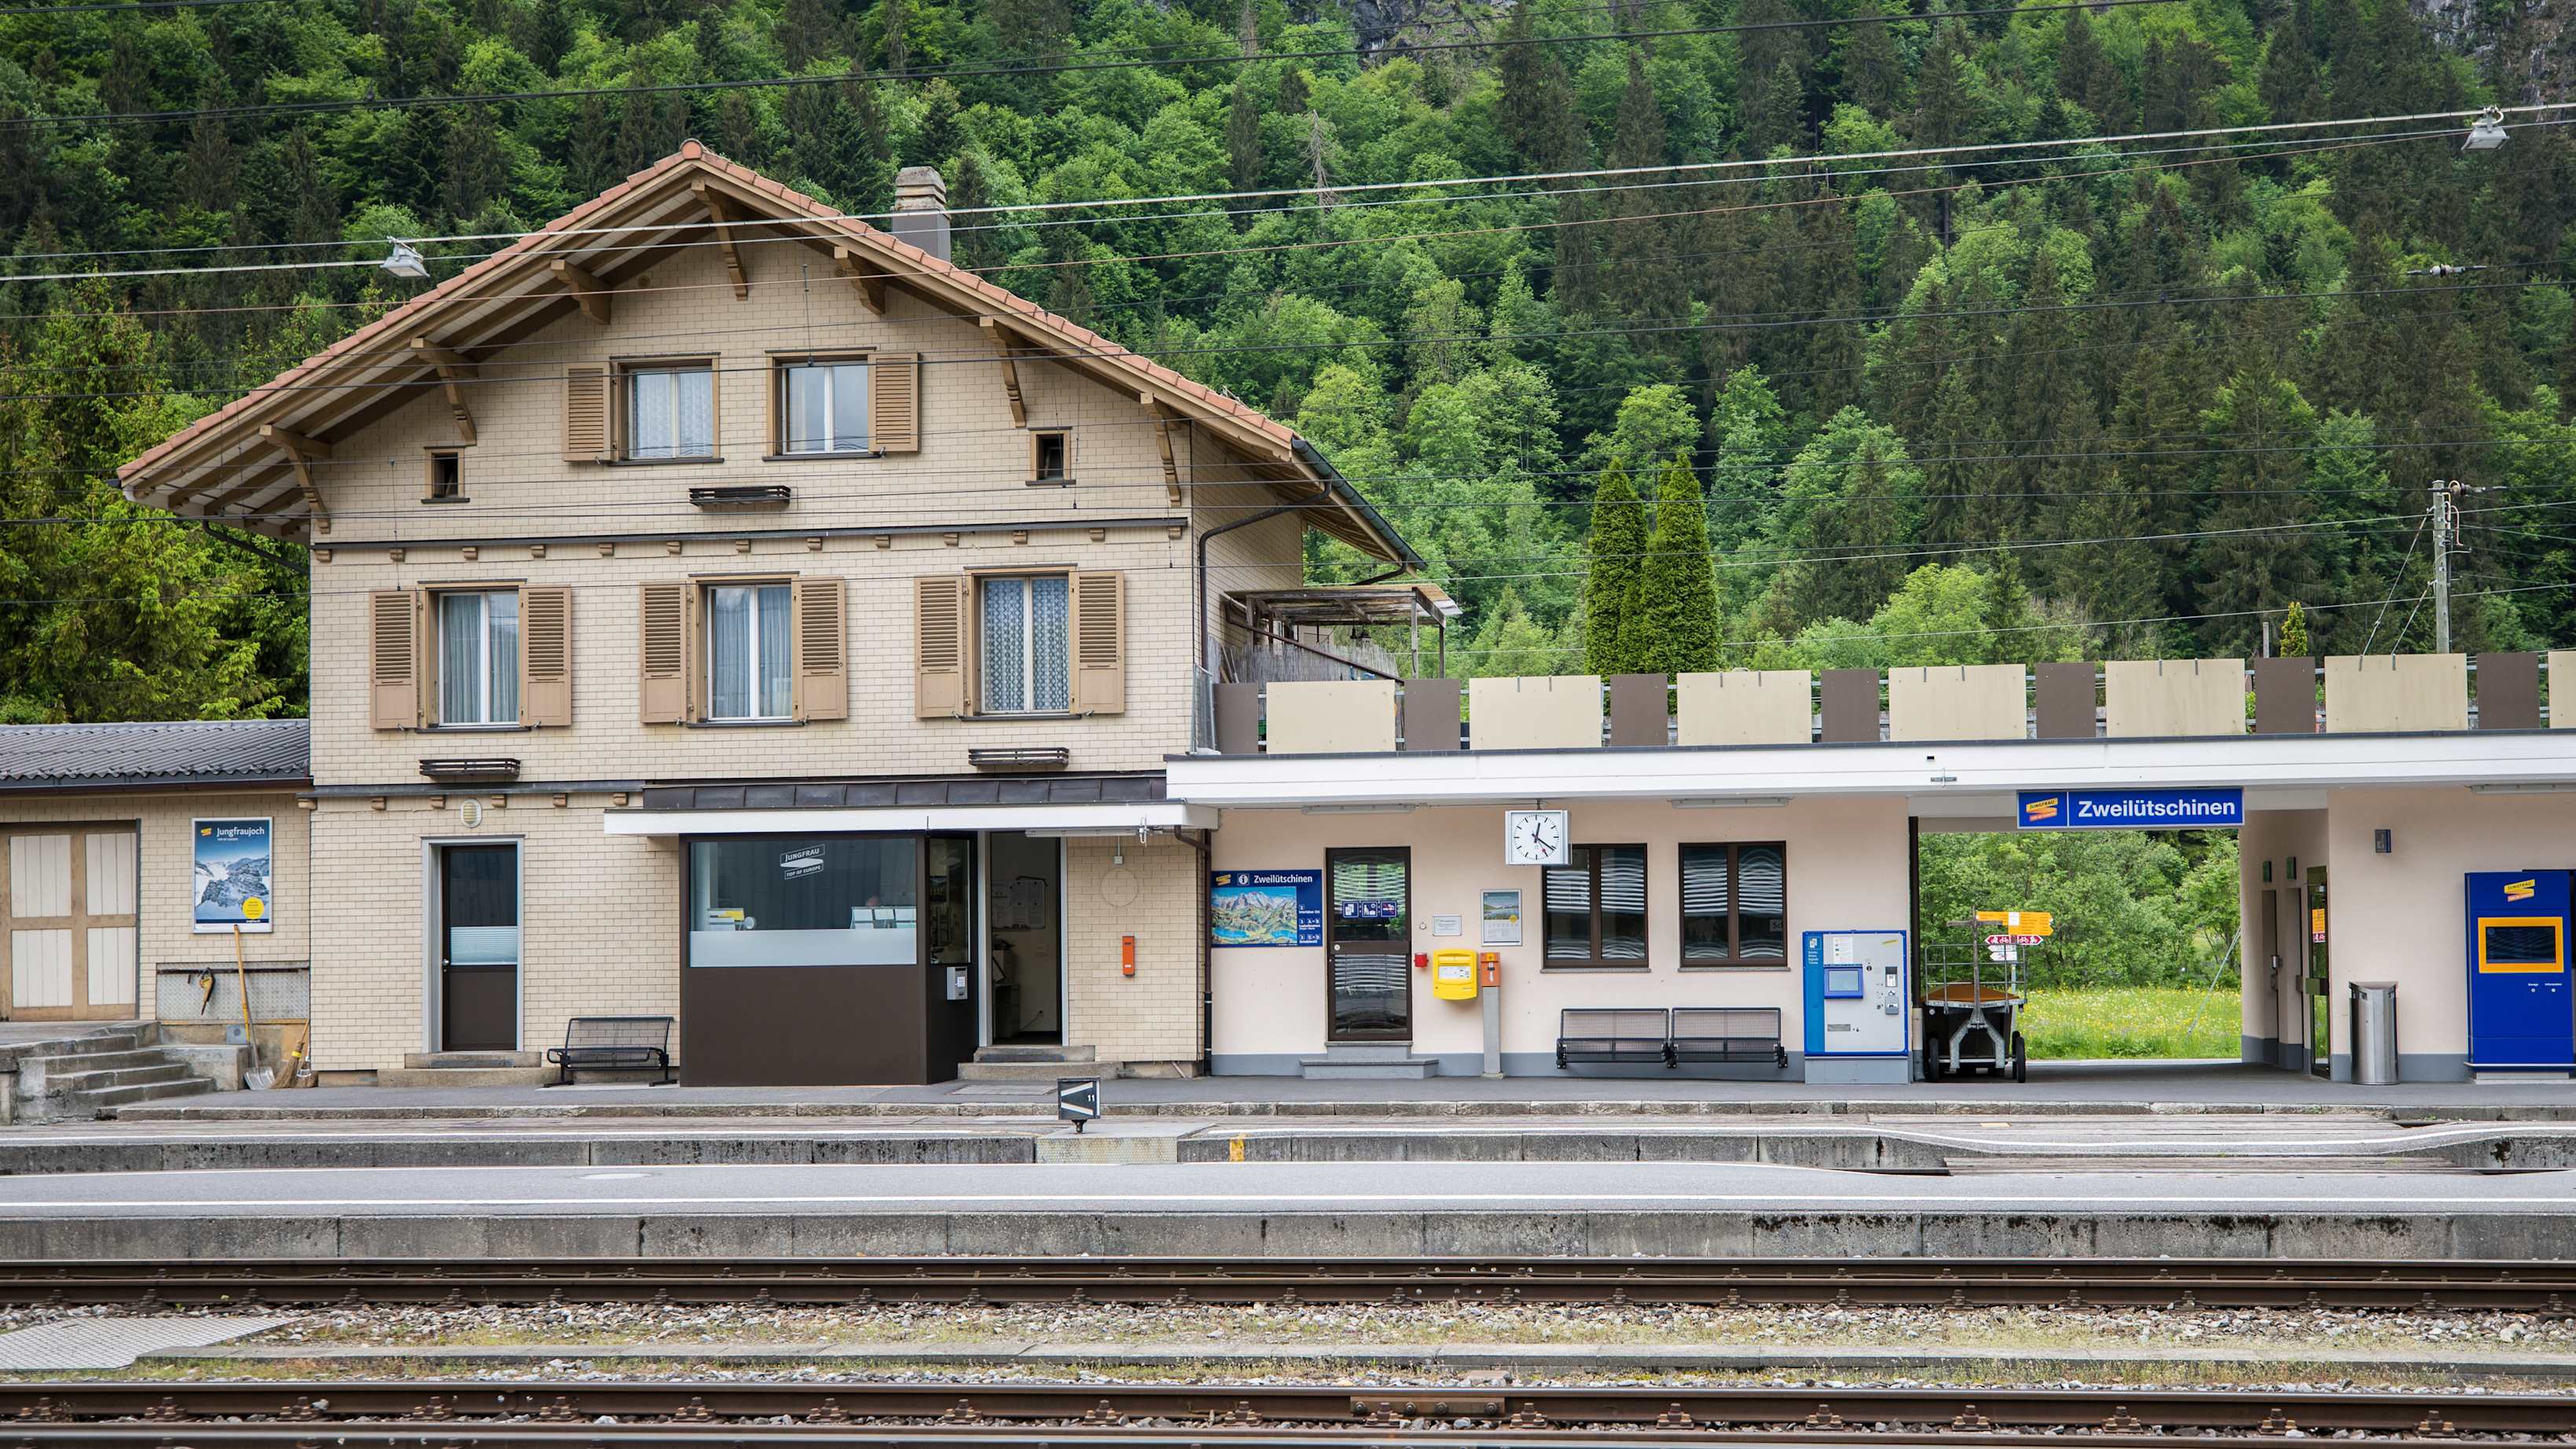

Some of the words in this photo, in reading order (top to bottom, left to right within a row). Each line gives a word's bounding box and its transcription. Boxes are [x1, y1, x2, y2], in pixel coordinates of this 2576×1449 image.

[2078, 798, 2235, 817] Zweilütschinen
[216, 827, 265, 838] Jungfraujoch
[785, 848, 820, 862] JUNGFRAU
[1253, 874, 1313, 884] Zweilütschinen
